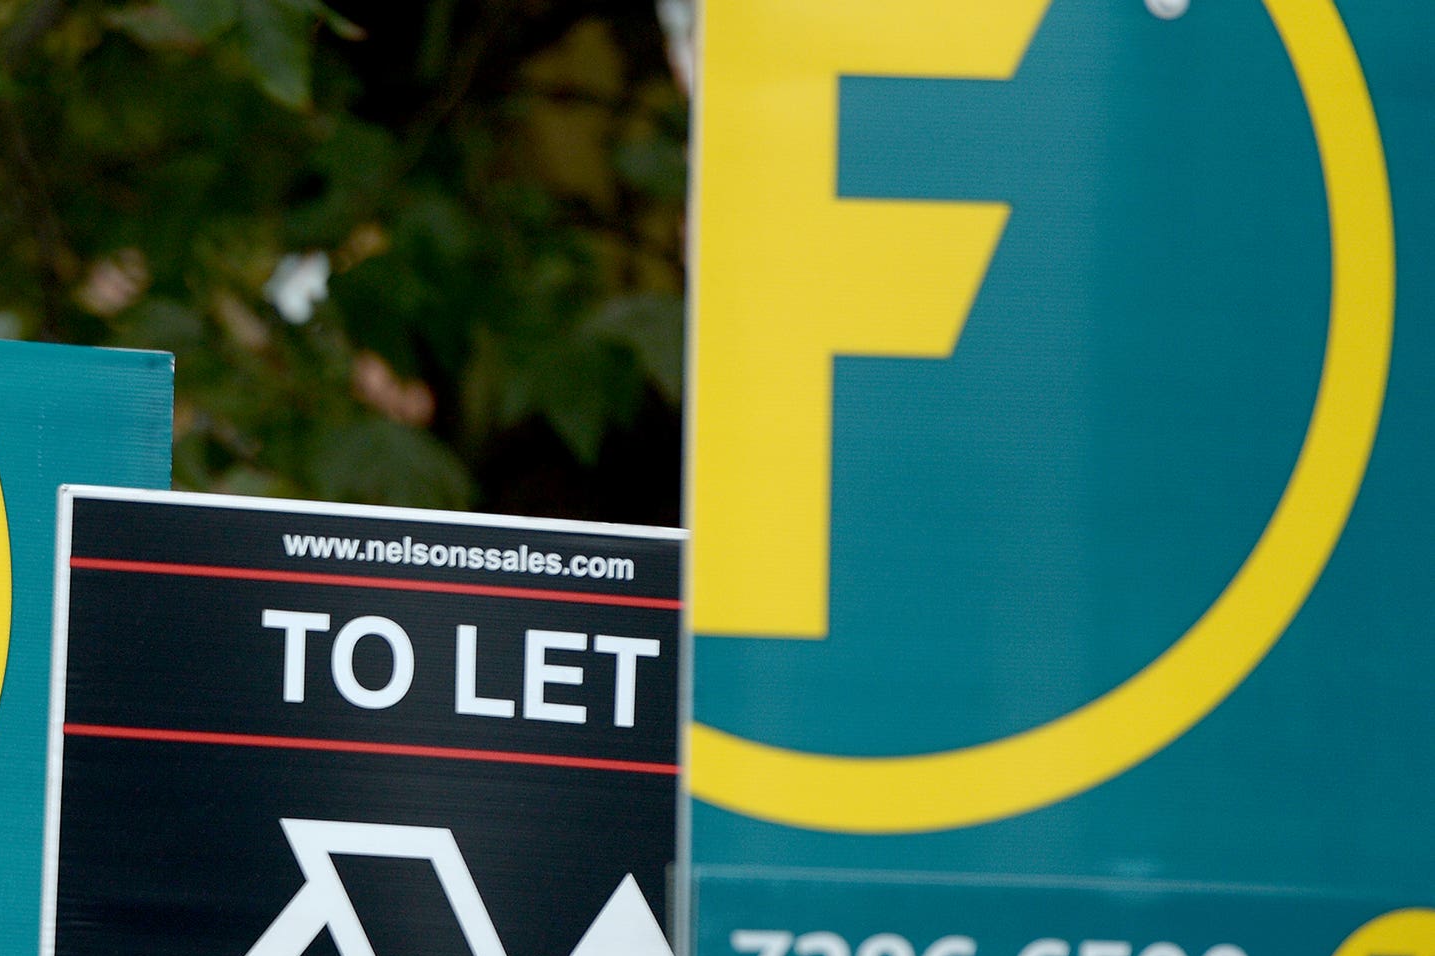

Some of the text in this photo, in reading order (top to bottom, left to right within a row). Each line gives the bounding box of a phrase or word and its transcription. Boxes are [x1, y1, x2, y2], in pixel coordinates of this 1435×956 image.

[283, 534, 635, 580] www.nelsonssales.com
[262, 609, 660, 728] TO LET
